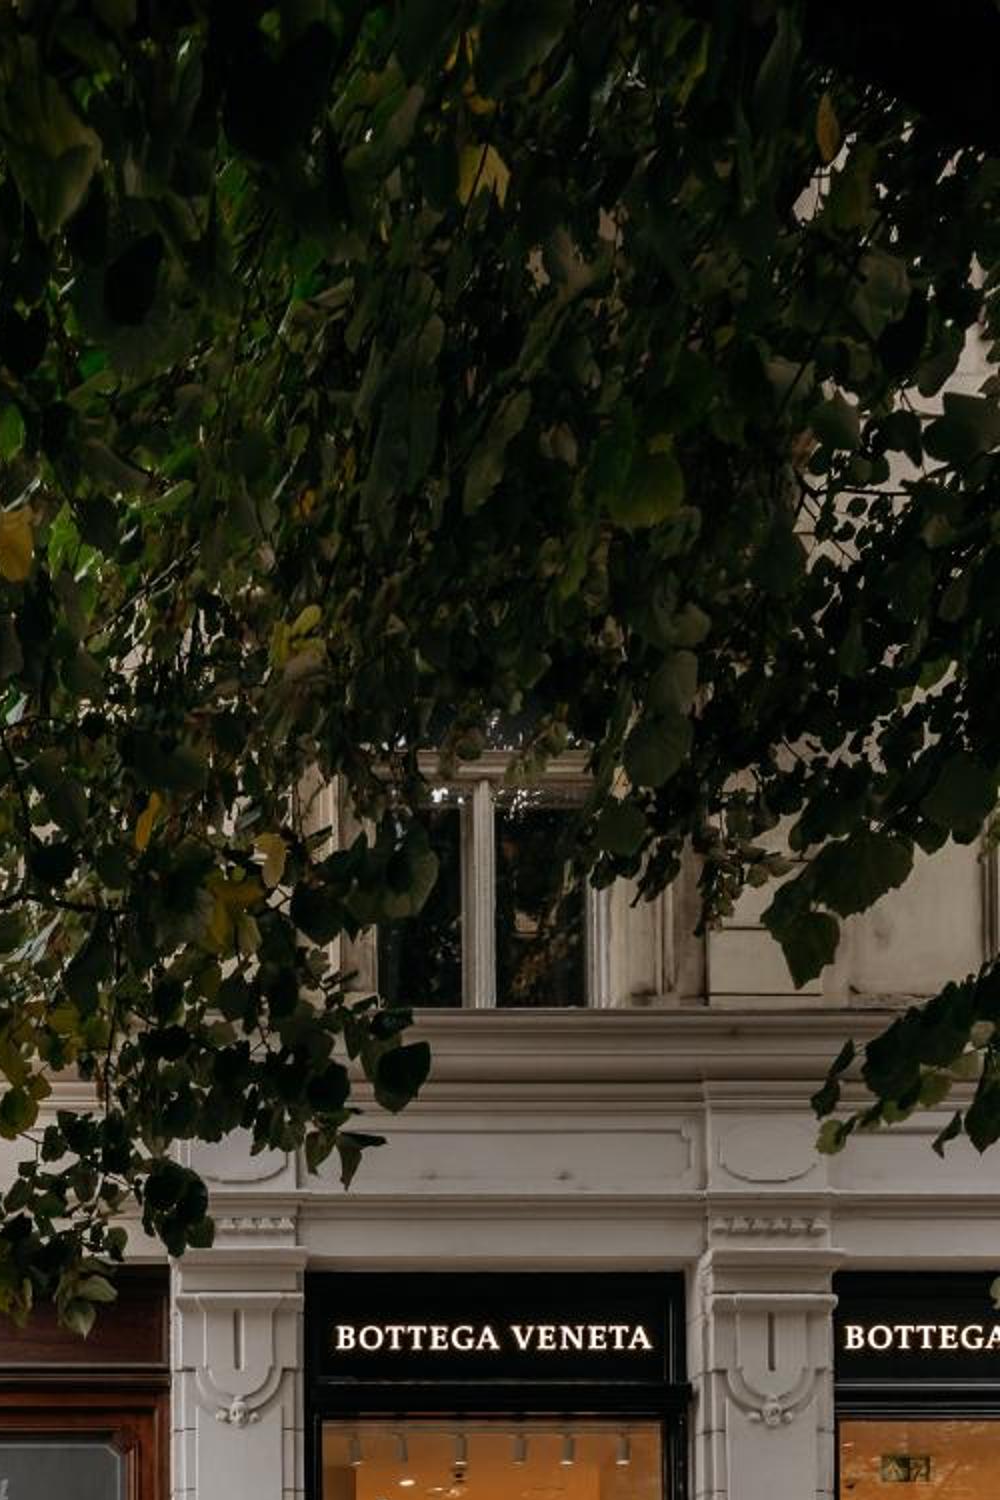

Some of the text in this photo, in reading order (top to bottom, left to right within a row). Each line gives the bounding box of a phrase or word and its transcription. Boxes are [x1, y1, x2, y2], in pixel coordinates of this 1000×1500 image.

[336, 1325, 653, 1350] BOTTEGA VENETA
[844, 1325, 1000, 1350] BOTTEGA
